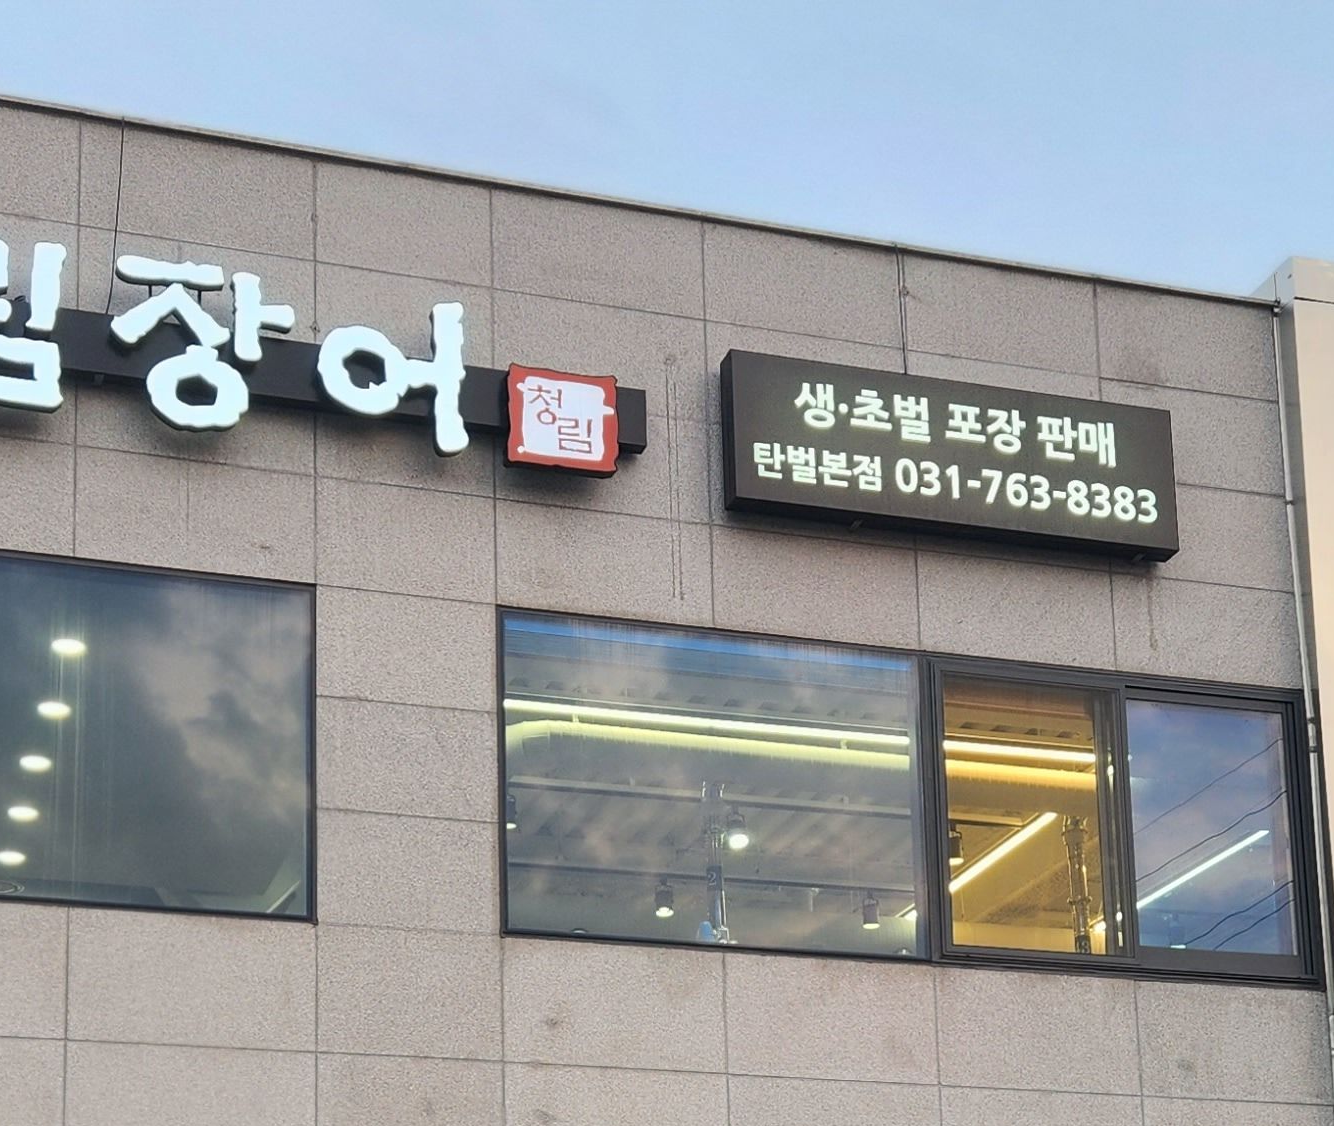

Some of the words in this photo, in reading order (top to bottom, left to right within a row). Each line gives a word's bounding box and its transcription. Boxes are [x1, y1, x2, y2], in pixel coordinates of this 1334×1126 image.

[526, 384, 593, 455] 청림
[946, 404, 1026, 455] 포장
[1037, 416, 1117, 468] 판매
[753, 441, 883, 492] 탄벌본점
[895, 458, 1158, 524] 031-763-8383
